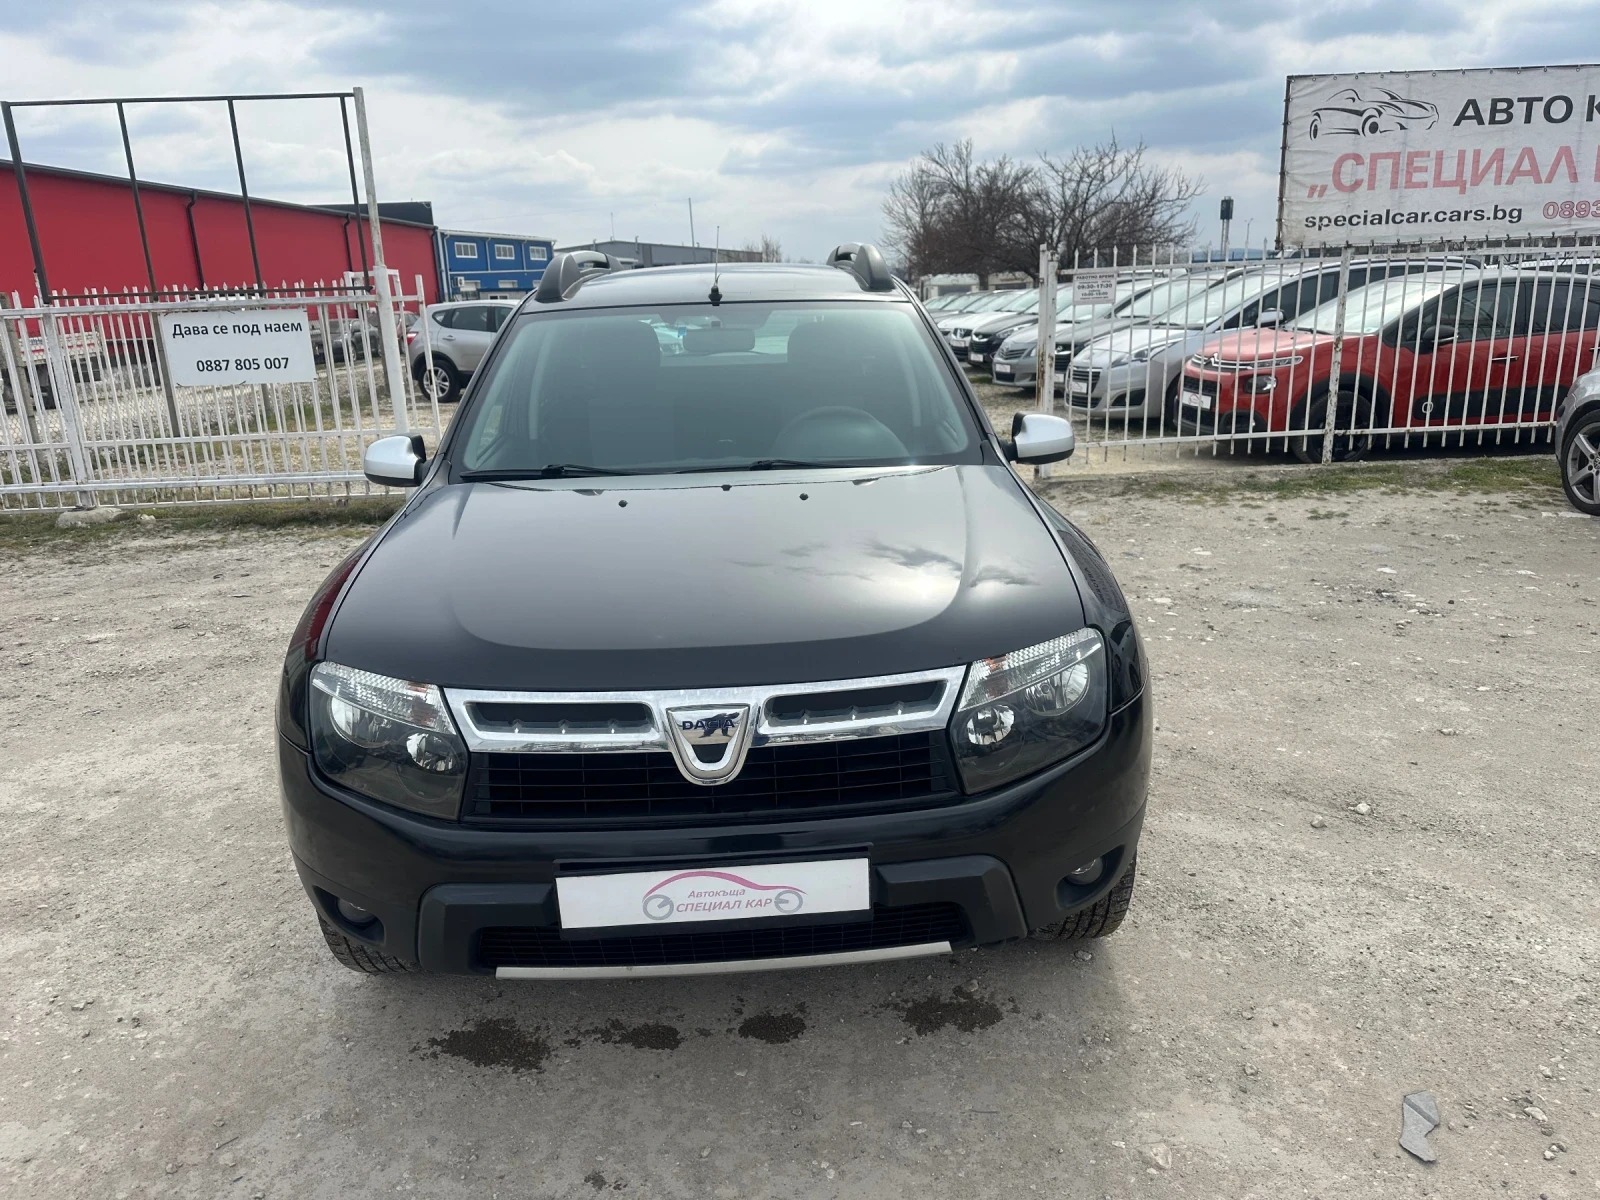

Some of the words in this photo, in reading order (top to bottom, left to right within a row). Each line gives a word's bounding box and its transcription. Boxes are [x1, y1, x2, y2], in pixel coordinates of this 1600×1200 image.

[1452, 94, 1574, 127] АВТО
[1304, 204, 1523, 231] specialcar.cars.bg
[172, 323, 209, 338] Дава
[212, 324, 229, 335] се
[232, 323, 261, 336] под
[264, 322, 303, 333] наем
[196, 359, 230, 372] 0887
[235, 358, 260, 371] 805
[264, 357, 289, 370] 007
[682, 719, 735, 731] DACIA
[687, 888, 746, 898] Автокъща
[676, 900, 742, 913] СПЕЦИАЛ
[745, 898, 773, 909] КАР
